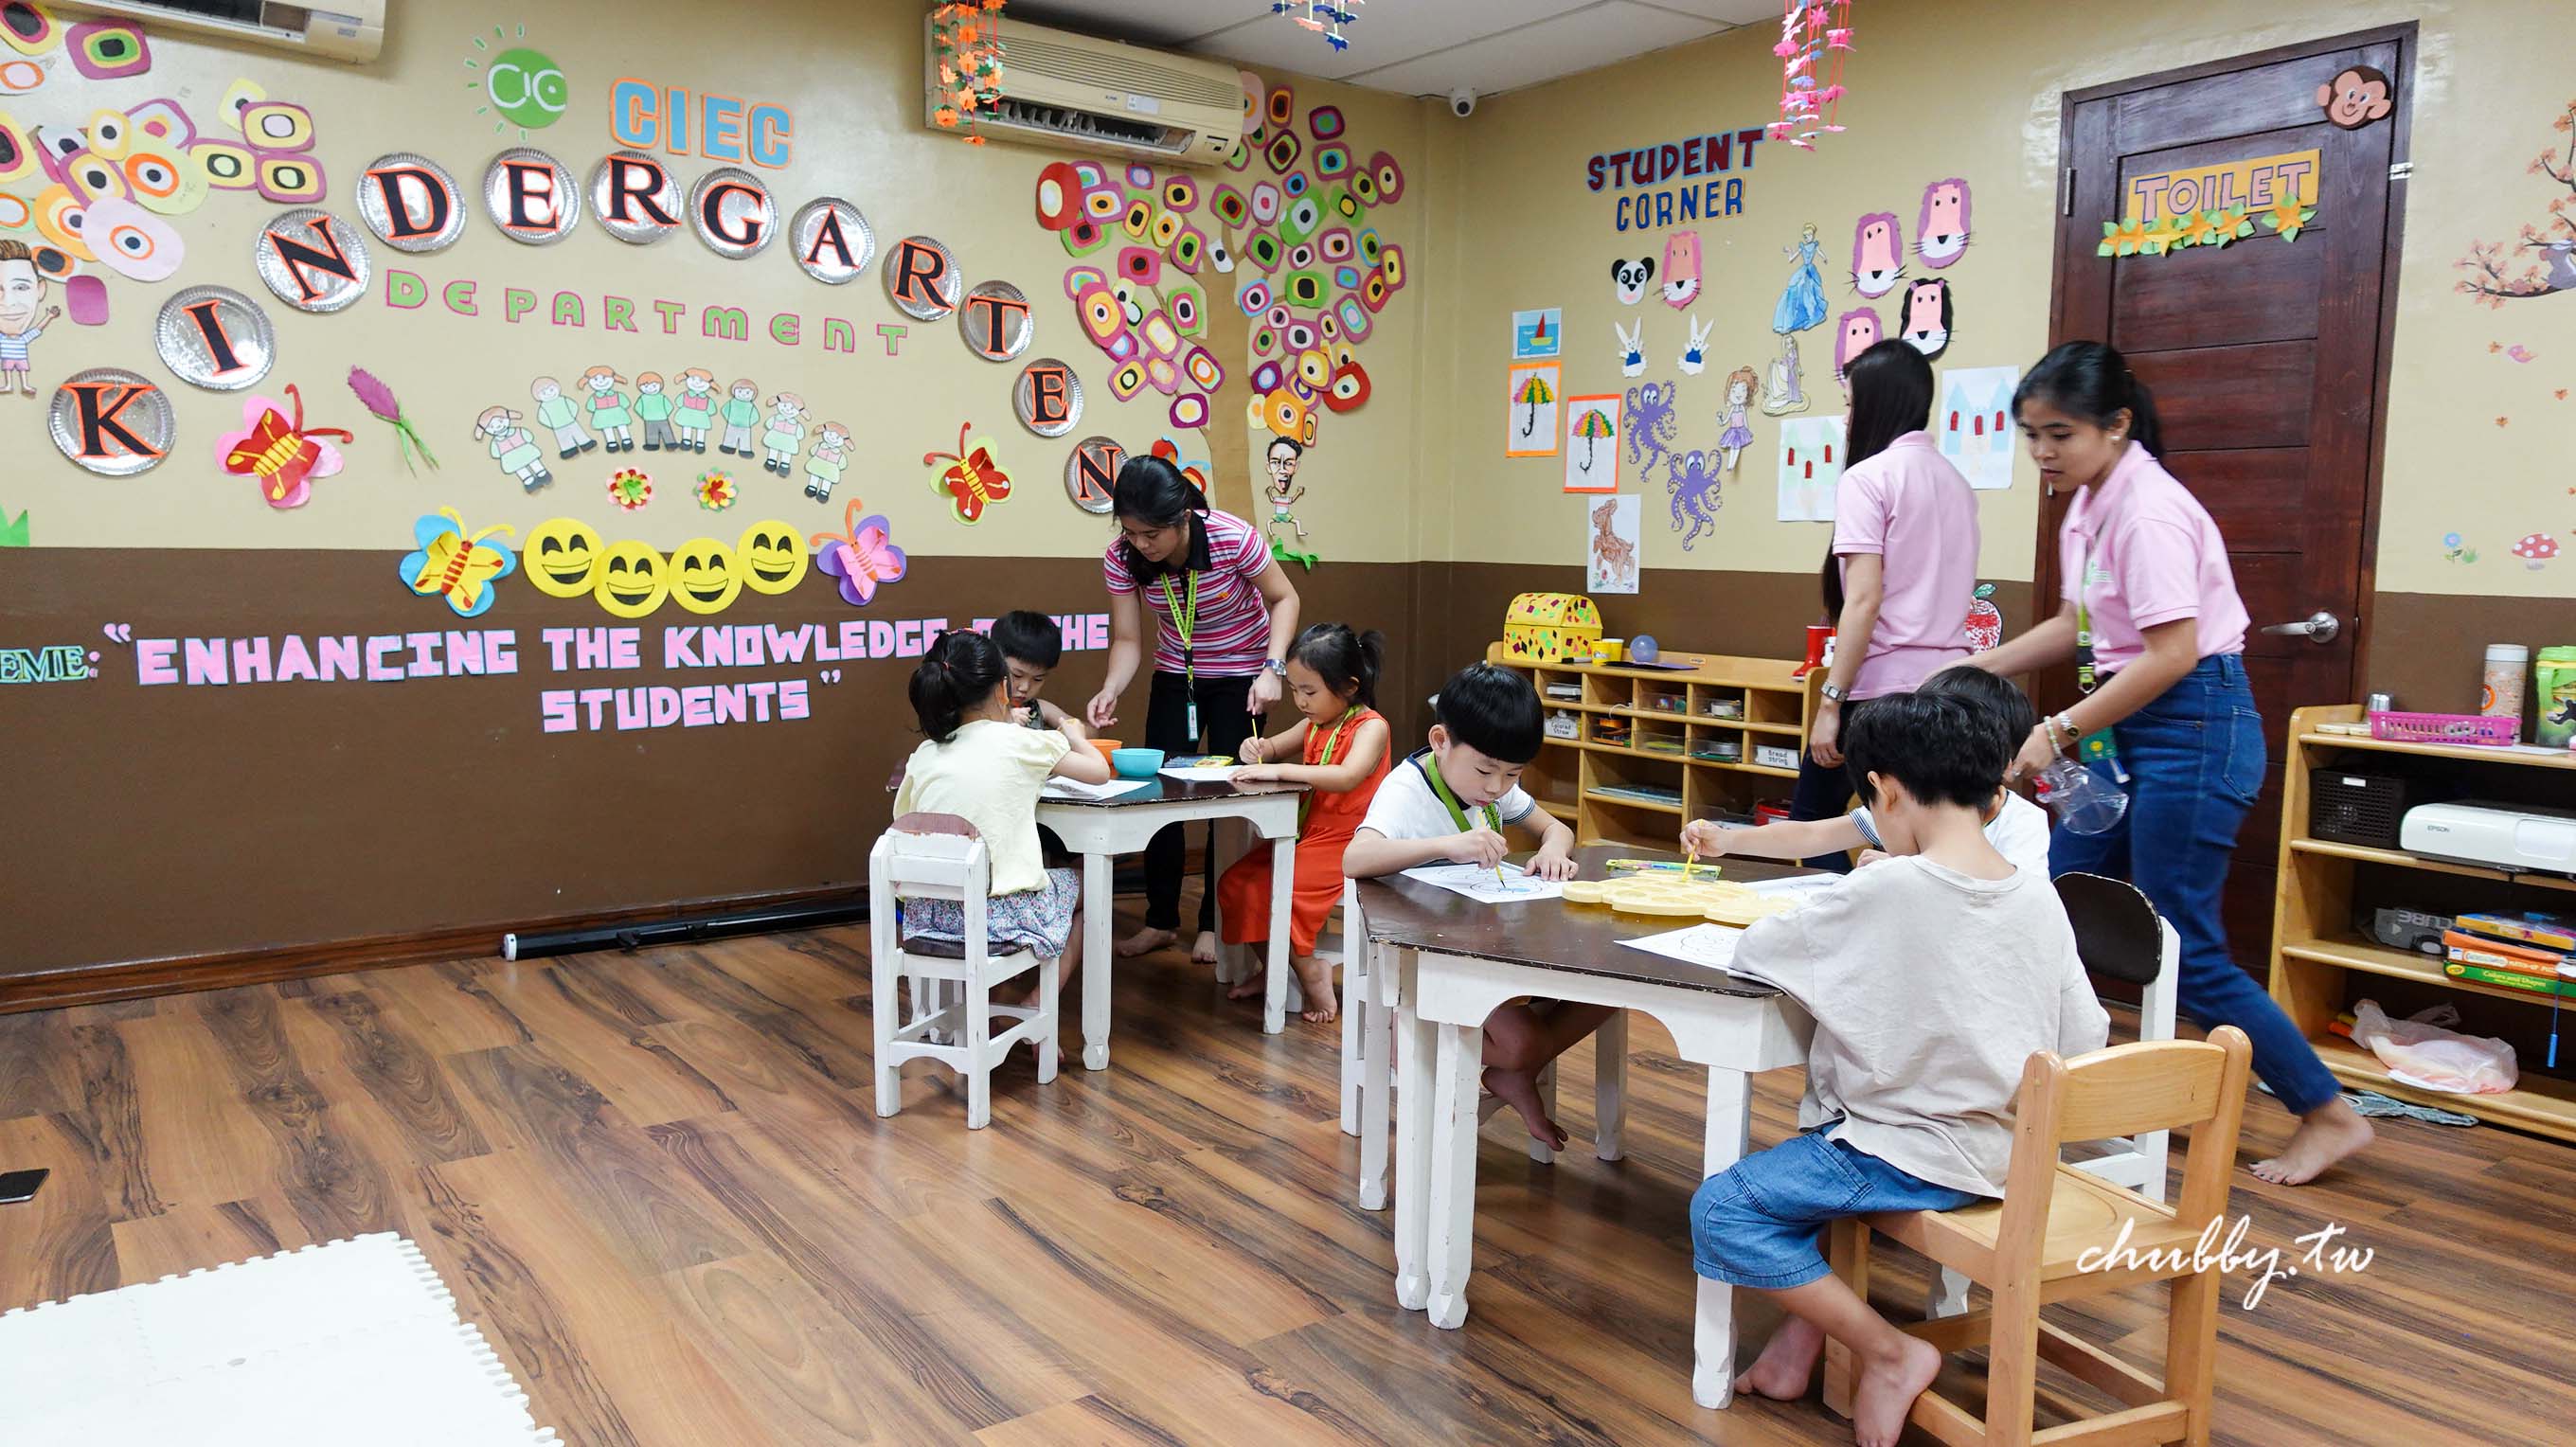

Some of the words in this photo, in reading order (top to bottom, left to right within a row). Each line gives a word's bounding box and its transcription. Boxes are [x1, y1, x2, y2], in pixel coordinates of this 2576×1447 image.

[610, 77, 795, 170] CIEC
[1587, 127, 1766, 193] STUDENT
[2135, 160, 2312, 224] TOILET
[1616, 177, 1746, 233] CORNER
[542, 626, 640, 670] THE
[664, 617, 948, 669] KNOWLEDGE
